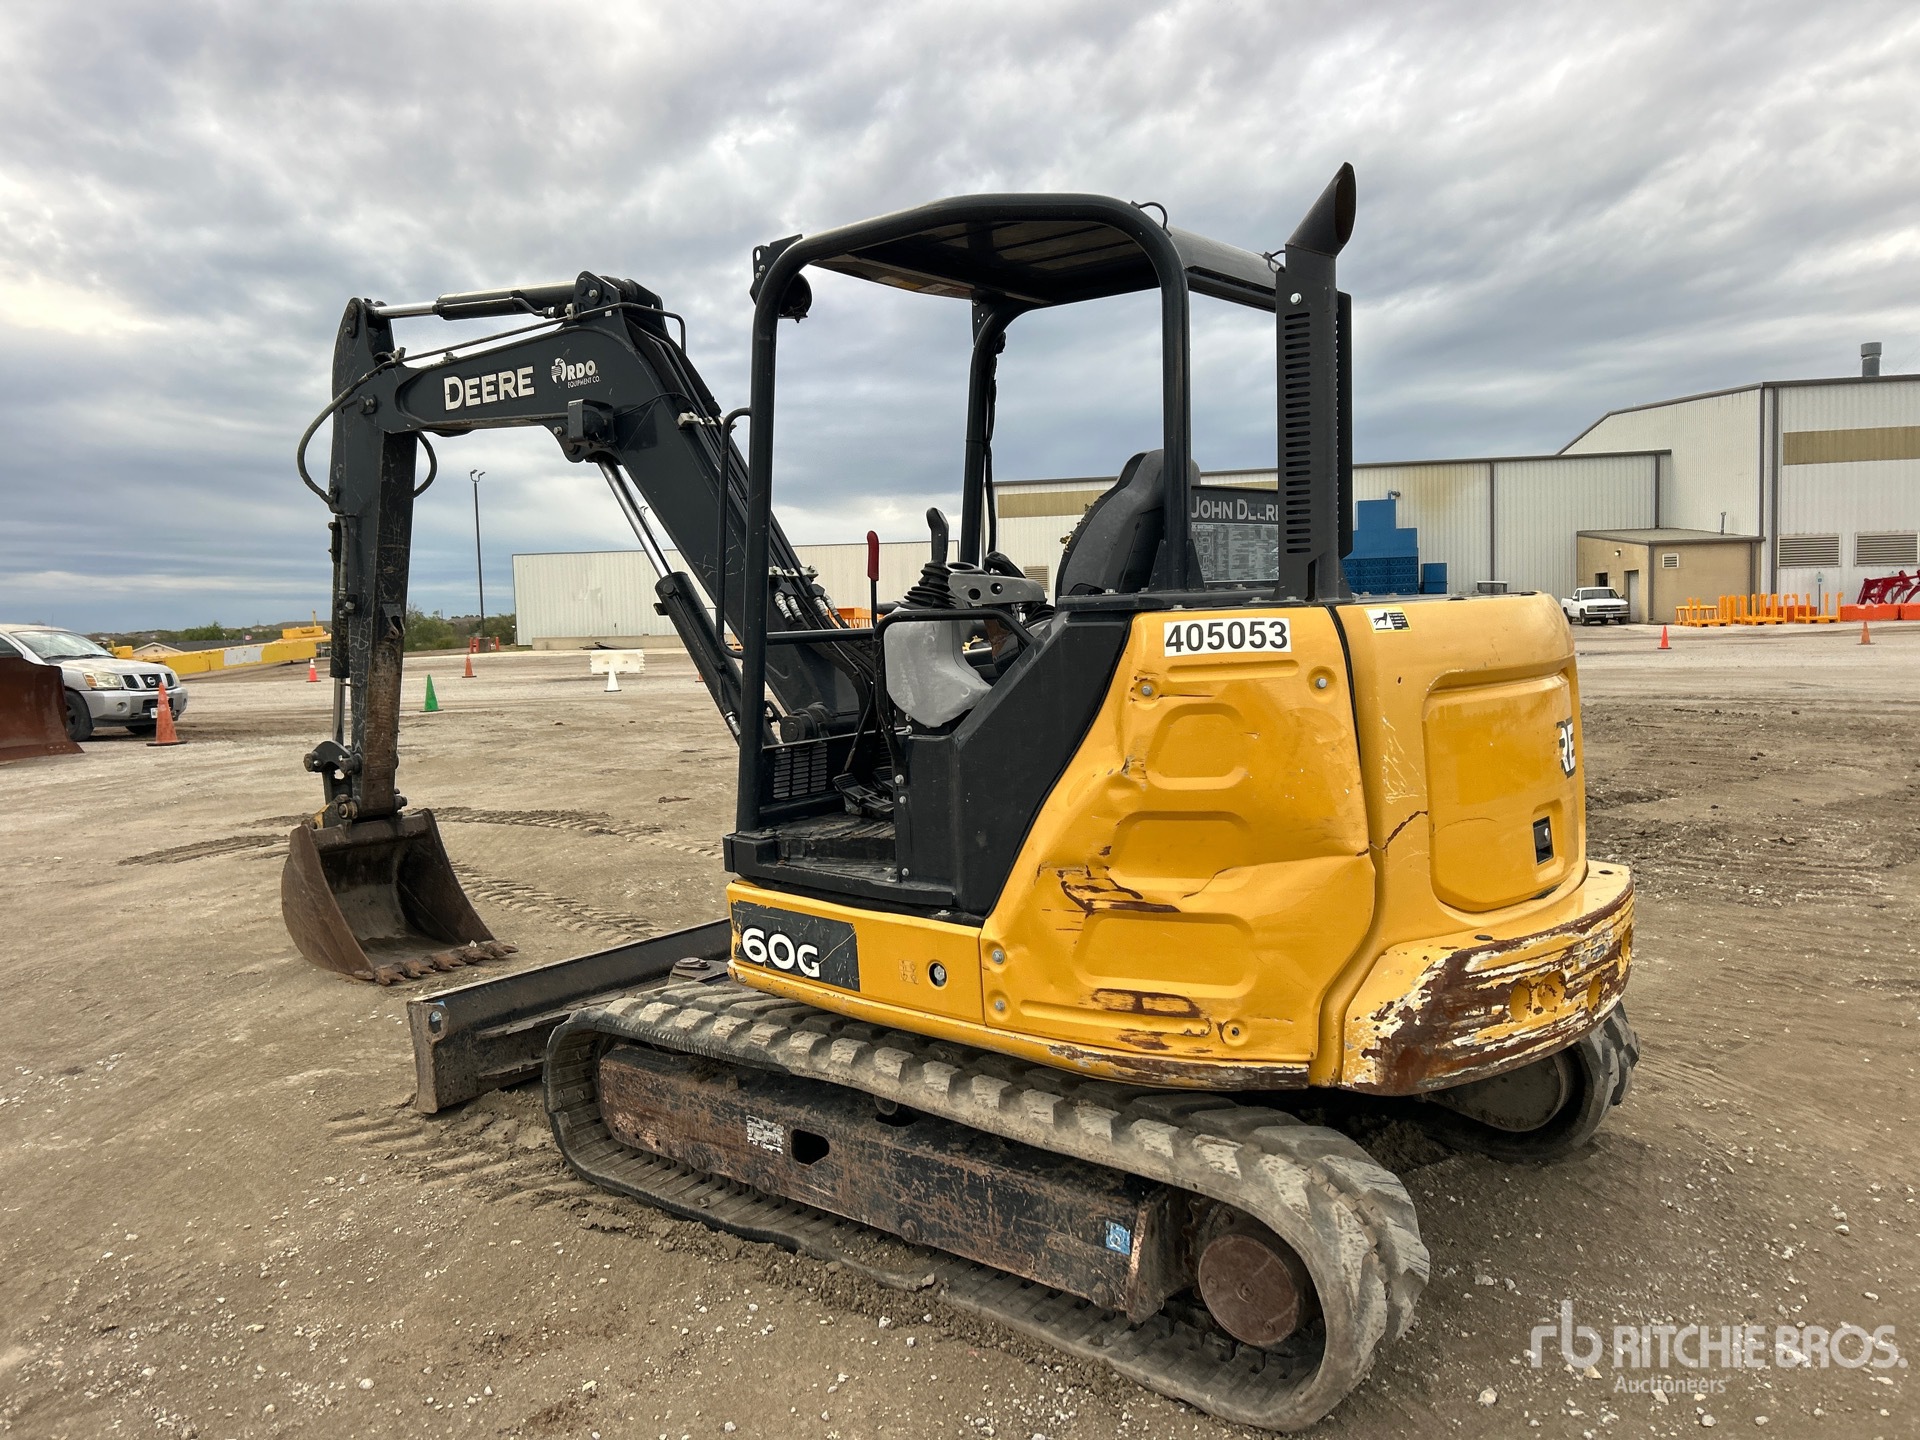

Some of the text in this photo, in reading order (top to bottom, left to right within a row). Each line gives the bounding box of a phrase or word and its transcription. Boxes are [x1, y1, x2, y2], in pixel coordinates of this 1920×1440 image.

[567, 360, 596, 381] RDO
[444, 366, 535, 411] DEERE
[1191, 496, 1233, 520] JOHN
[1165, 621, 1288, 653] 405053
[742, 927, 821, 978] 60G
